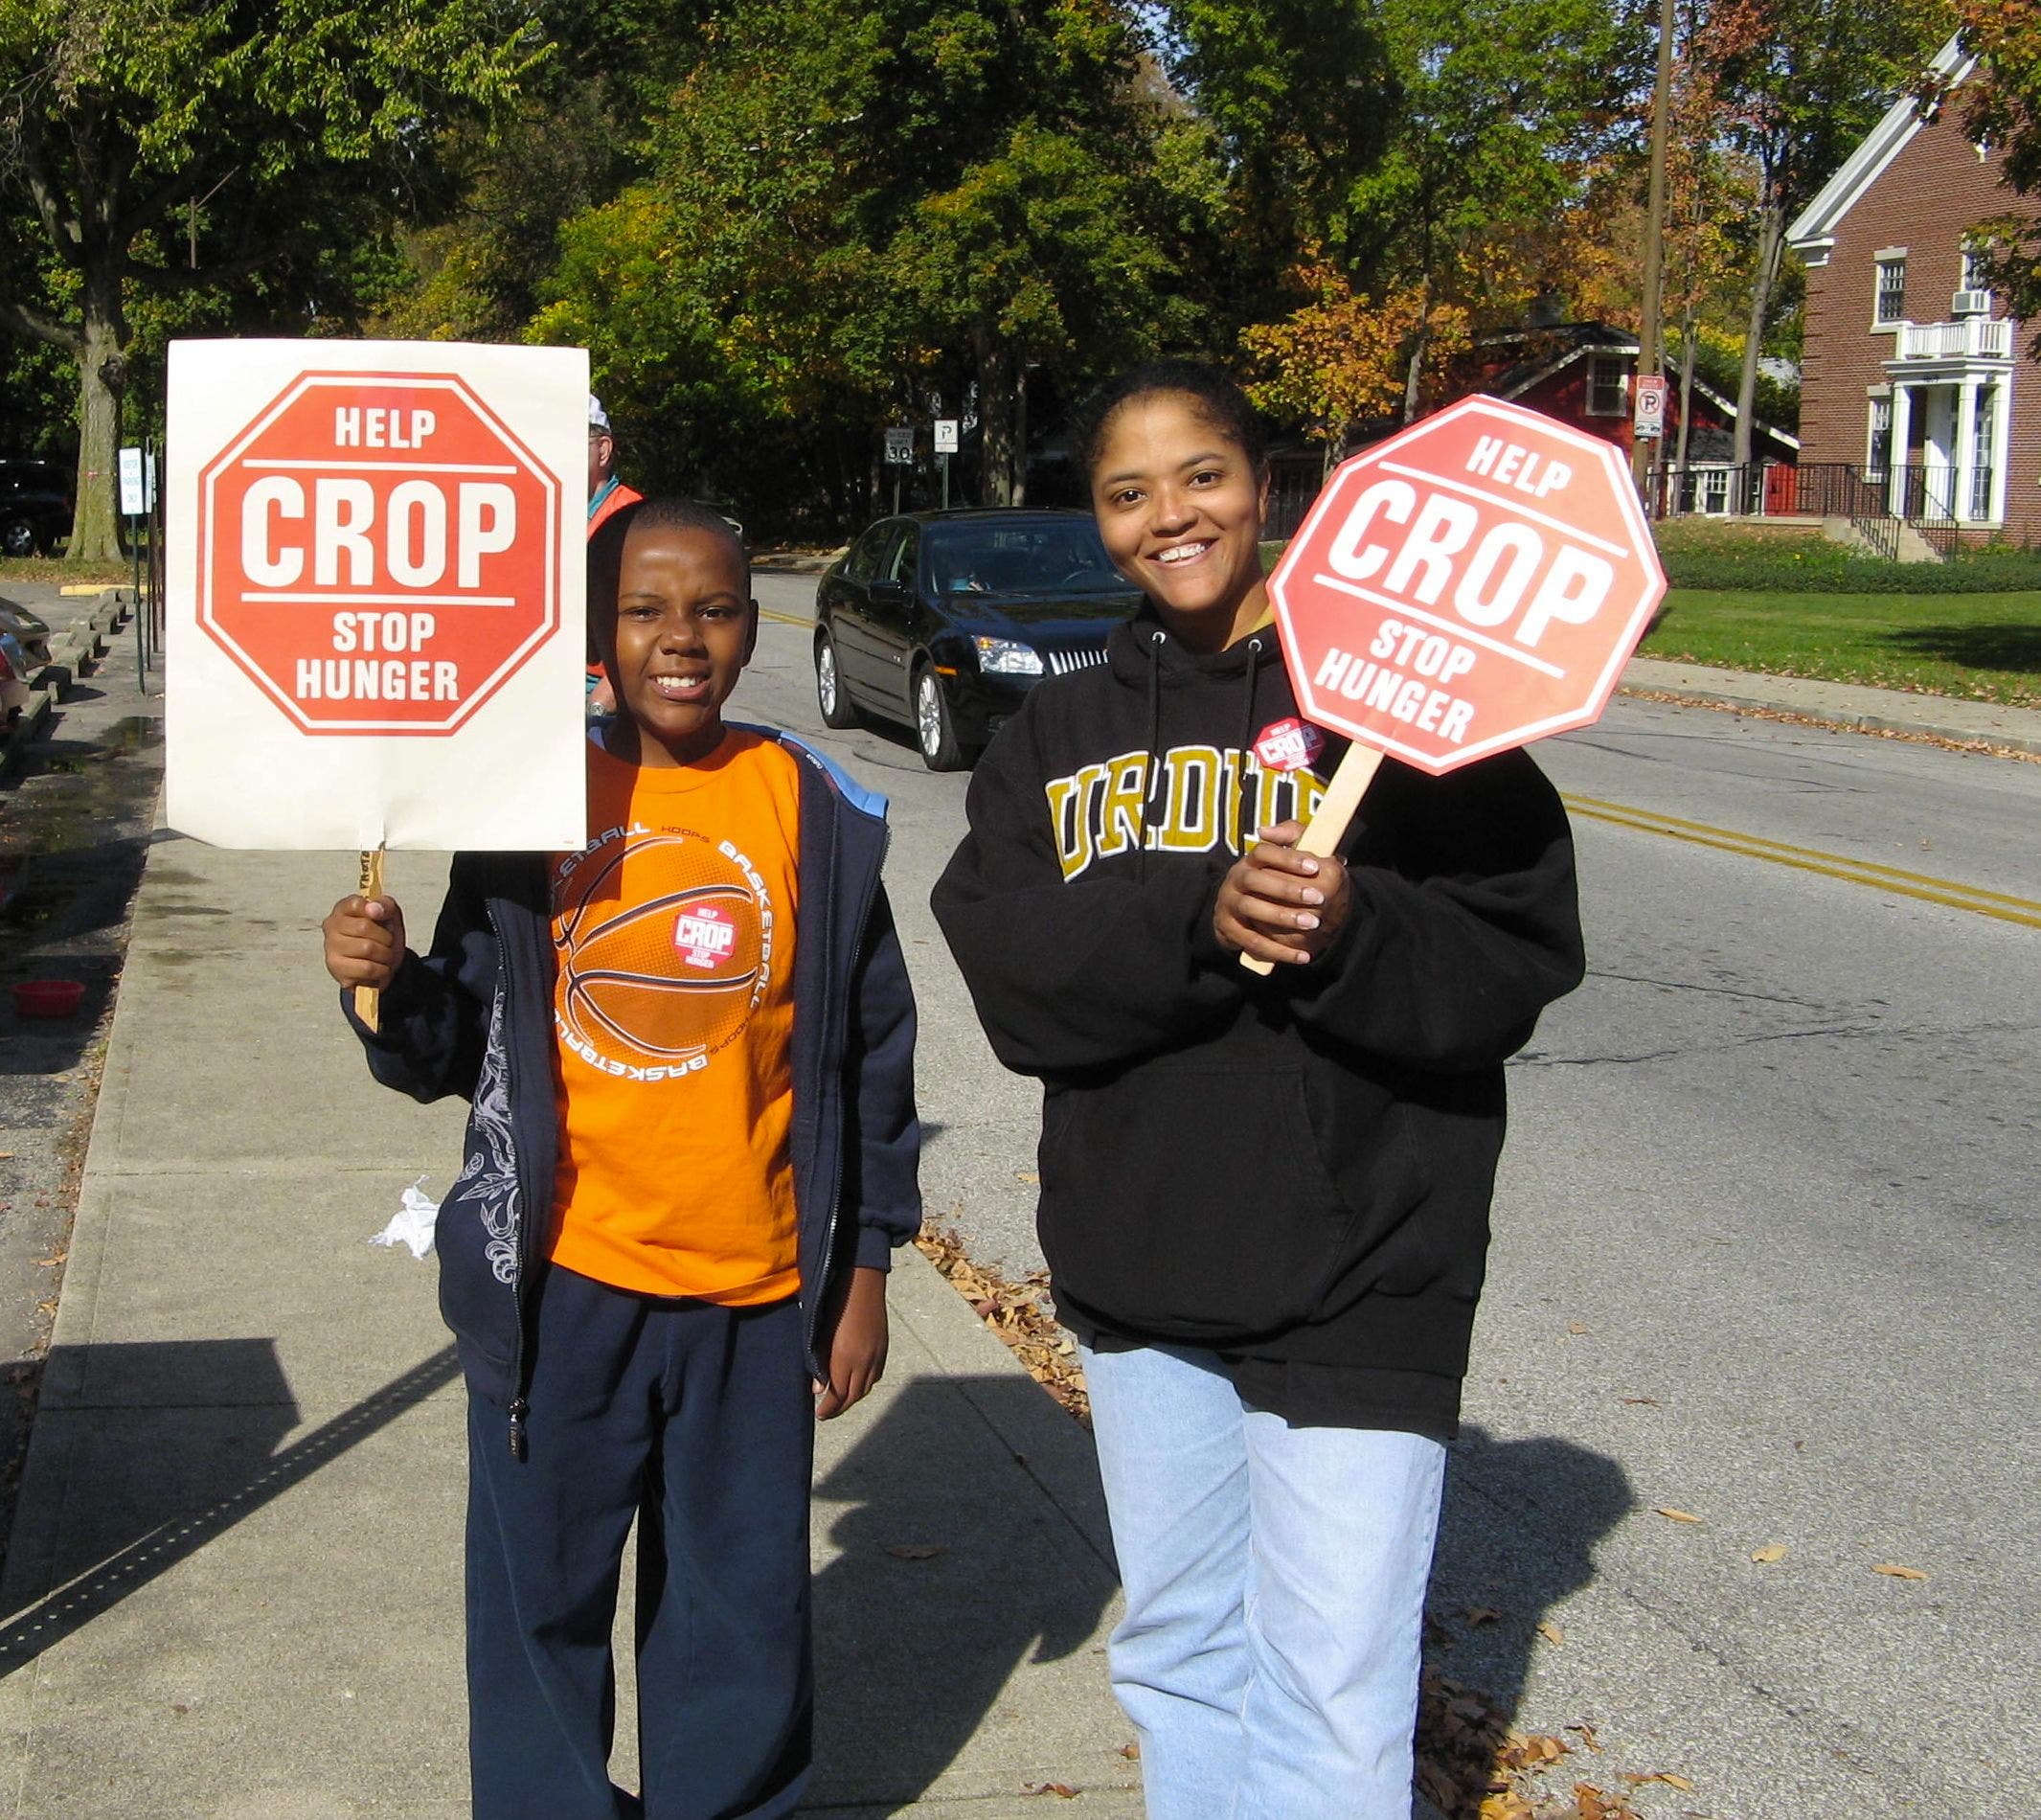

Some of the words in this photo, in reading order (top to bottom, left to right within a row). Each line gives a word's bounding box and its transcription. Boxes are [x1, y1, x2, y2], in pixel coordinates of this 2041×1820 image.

[335, 407, 436, 448] HELP
[888, 445, 911, 460] 30
[1464, 435, 1573, 499] HELP
[240, 475, 517, 588] CROP
[1328, 479, 1618, 648] CROP
[332, 612, 436, 652] STOP
[1369, 618, 1477, 685] STOP
[296, 658, 459, 700] HUNGER
[1313, 647, 1476, 745] HUNGER
[1258, 726, 1318, 764] CROP
[661, 825, 712, 844] HOOPS
[675, 917, 735, 952] CROP
[716, 839, 773, 1010] BASKETBALL
